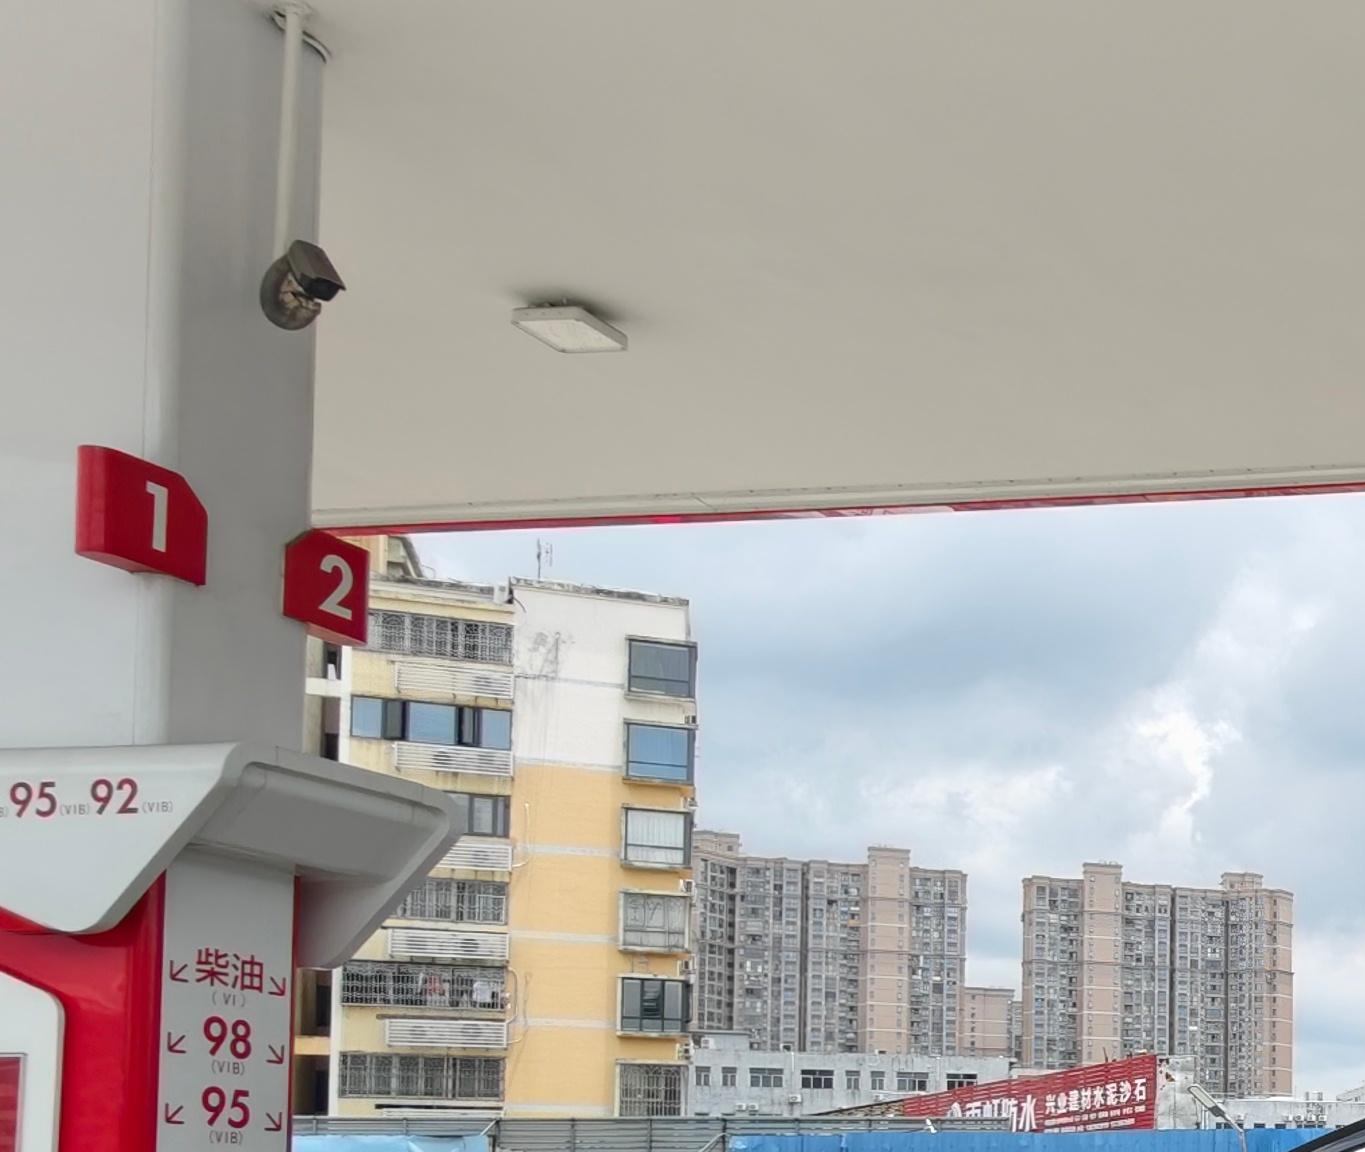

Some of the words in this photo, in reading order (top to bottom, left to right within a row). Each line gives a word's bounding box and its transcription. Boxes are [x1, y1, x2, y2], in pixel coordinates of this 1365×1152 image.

[145, 481, 169, 553] 1
[318, 553, 354, 620] 2
[9, 781, 57, 818] 95
[90, 777, 139, 815] 92
[195, 947, 264, 994] 柴油
[203, 1015, 252, 1060] 98
[201, 1085, 250, 1129] 95
